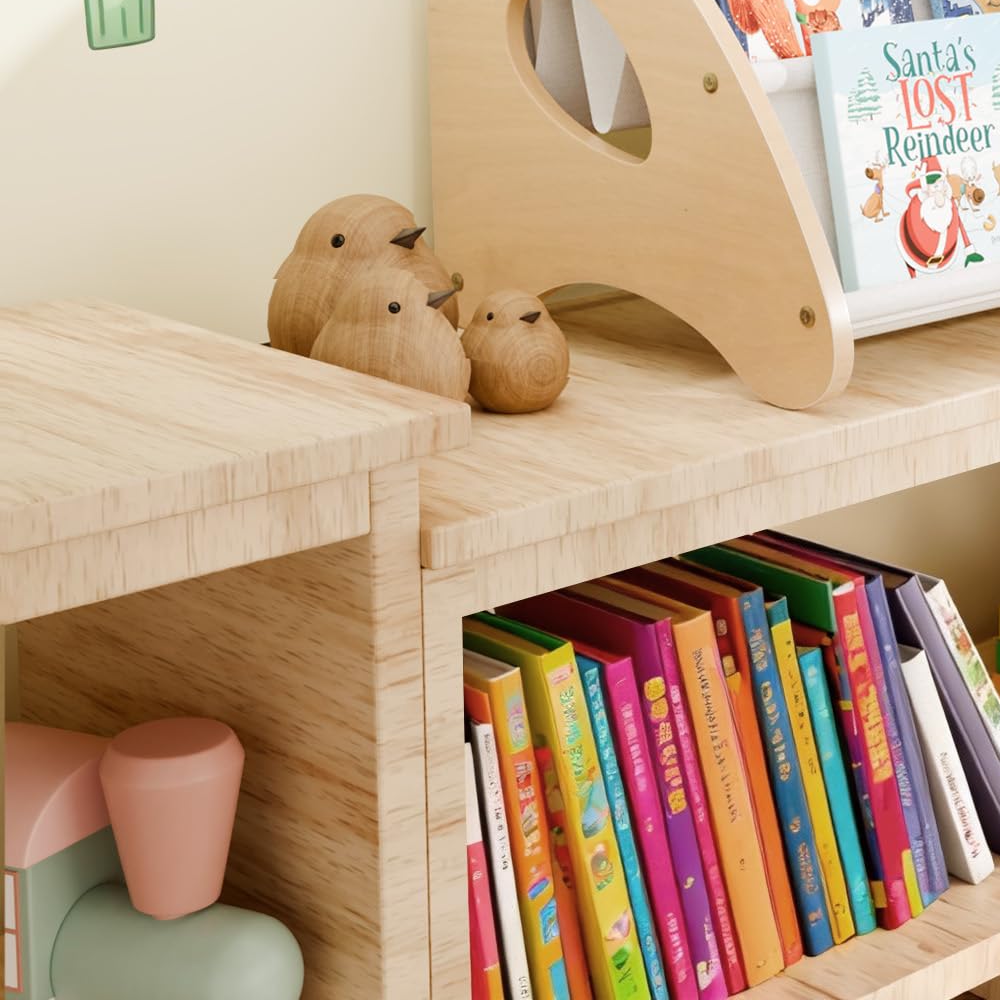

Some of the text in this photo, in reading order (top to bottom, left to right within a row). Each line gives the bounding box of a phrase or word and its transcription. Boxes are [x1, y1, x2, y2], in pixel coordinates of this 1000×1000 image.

[882, 36, 977, 82] Santa's
[898, 72, 974, 131] LOST
[882, 123, 995, 167] Reindeer
